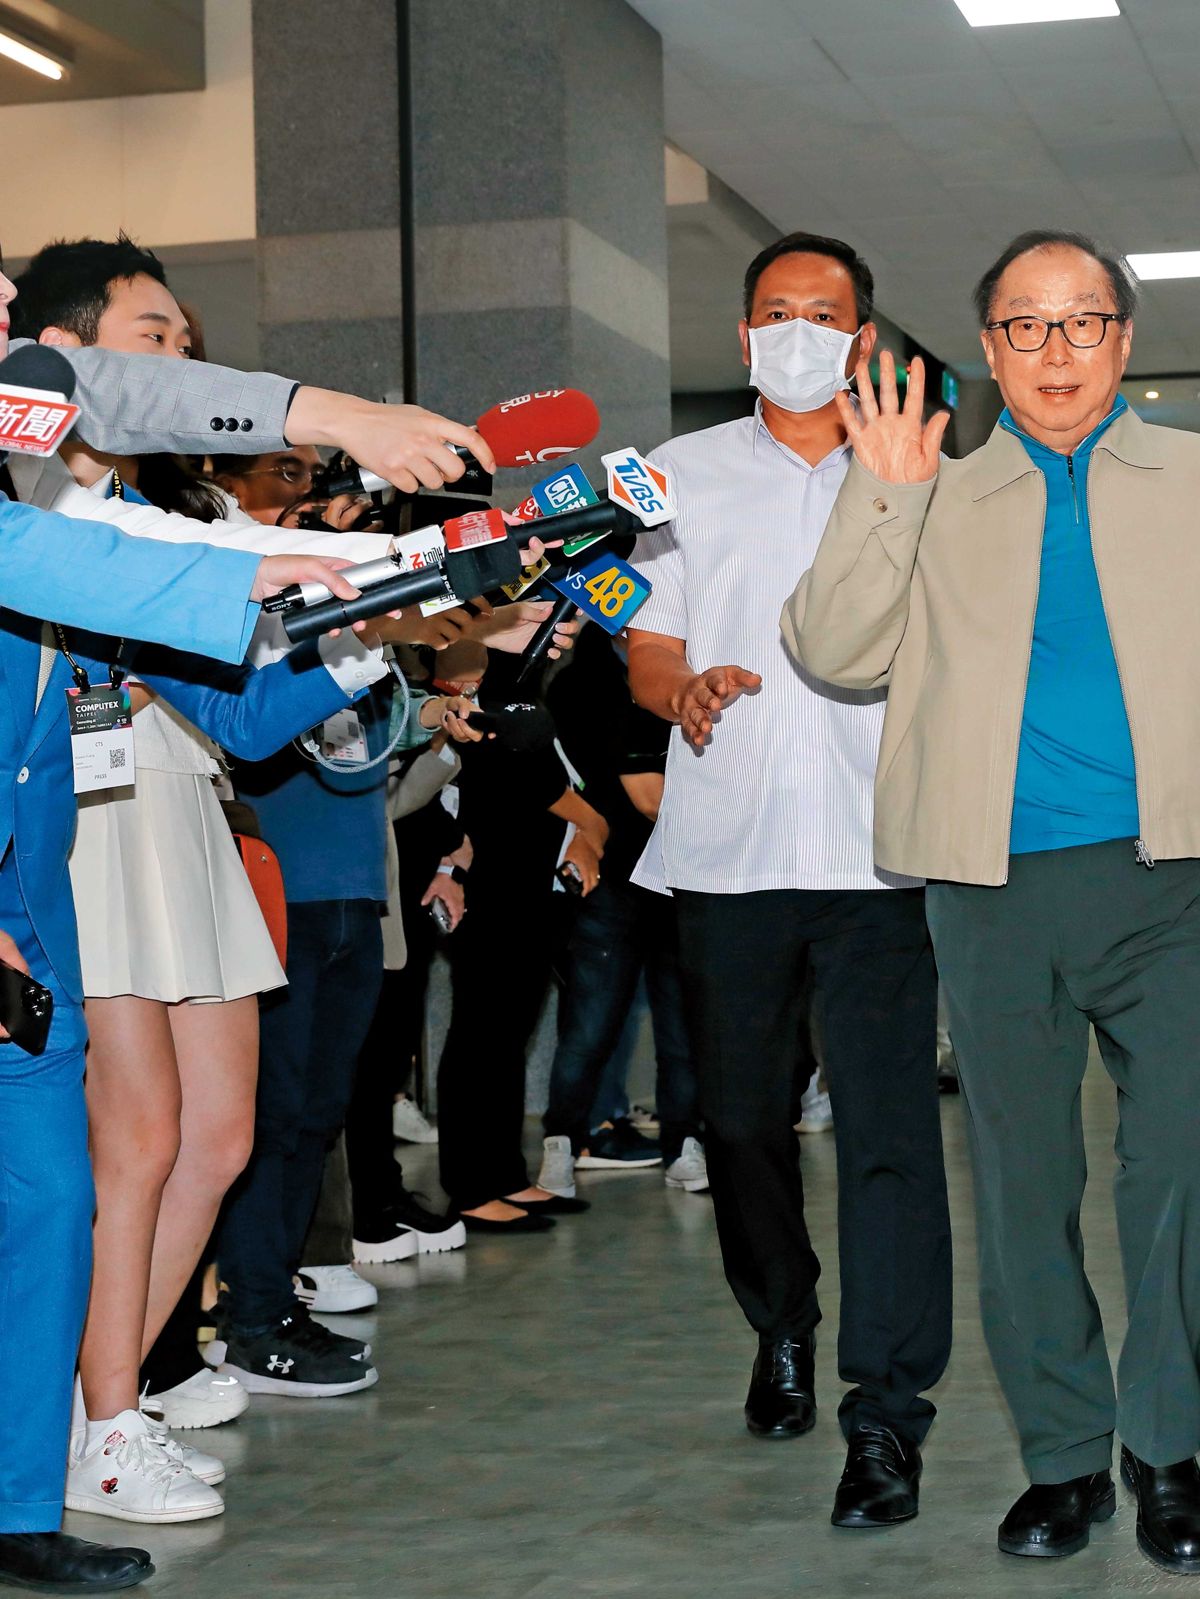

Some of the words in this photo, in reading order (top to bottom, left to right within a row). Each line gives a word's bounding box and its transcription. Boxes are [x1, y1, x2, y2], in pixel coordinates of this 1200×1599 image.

[547, 477, 578, 506] CTS
[614, 456, 664, 513] TVBS
[584, 566, 637, 618] 48
[75, 700, 119, 713] COMPUTEX
